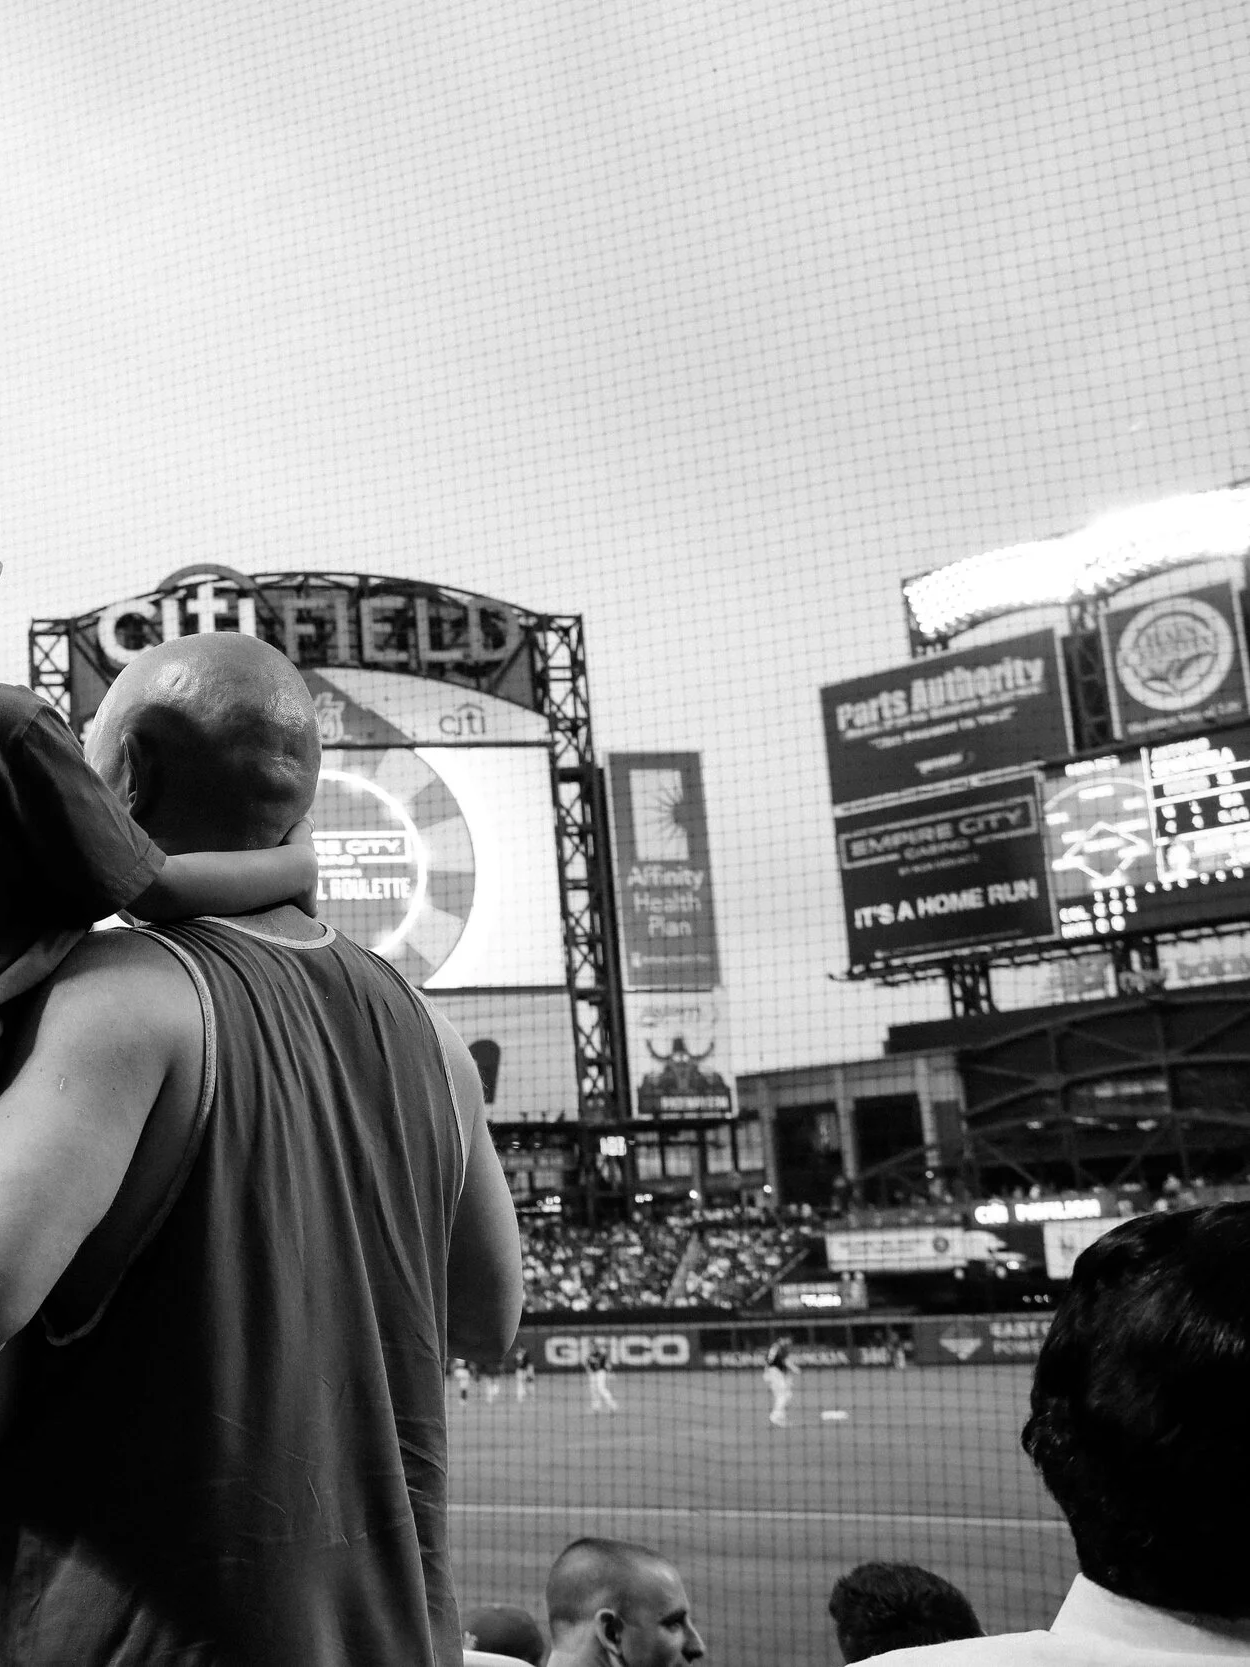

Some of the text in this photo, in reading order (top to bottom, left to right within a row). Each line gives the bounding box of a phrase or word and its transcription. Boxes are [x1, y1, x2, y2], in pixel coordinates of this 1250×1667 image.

[284, 597, 521, 663] FIELD
[836, 689, 909, 732] Parts
[911, 656, 1044, 712] Authority
[439, 704, 486, 735] citi
[850, 807, 1024, 858] EMPIRE CITY
[627, 865, 704, 891] Affinity
[633, 891, 702, 913] Health
[854, 878, 1039, 930] IT'S A HOME RUN
[648, 914, 692, 937] Plan
[1014, 1198, 1101, 1222] PAVILION
